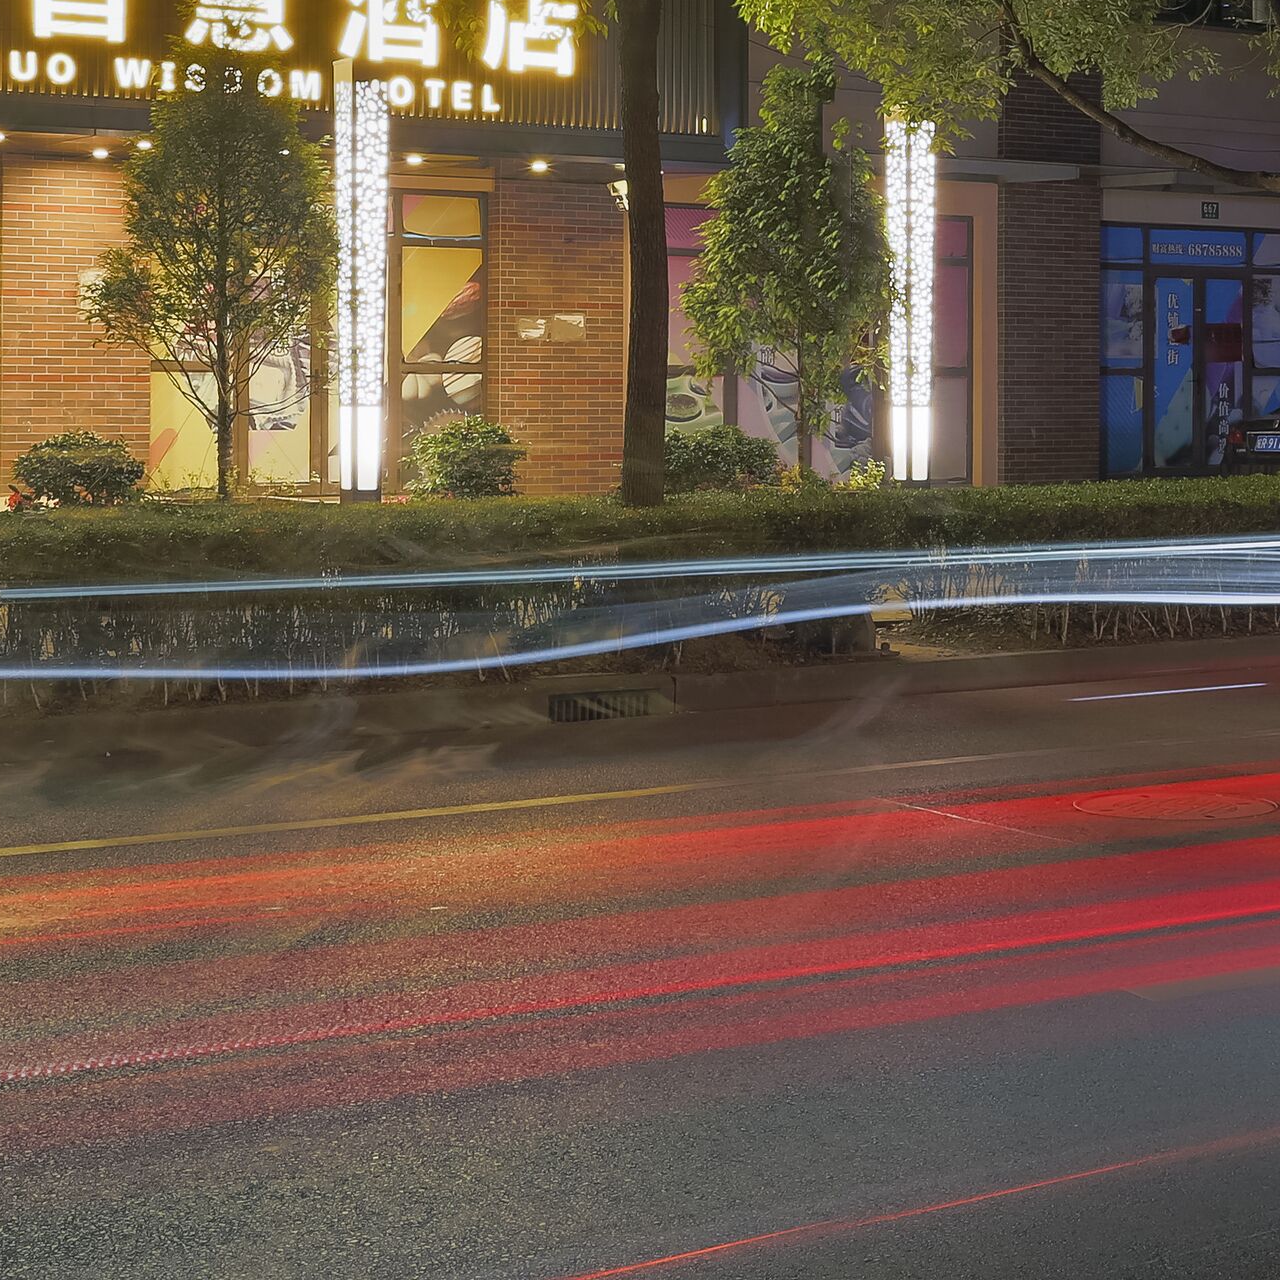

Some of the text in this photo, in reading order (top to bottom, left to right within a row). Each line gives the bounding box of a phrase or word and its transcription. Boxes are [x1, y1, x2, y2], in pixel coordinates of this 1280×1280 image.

[387, 76, 502, 113] OTEL
[1203, 203, 1217, 213] 667
[1188, 244, 1243, 257] 68785888
